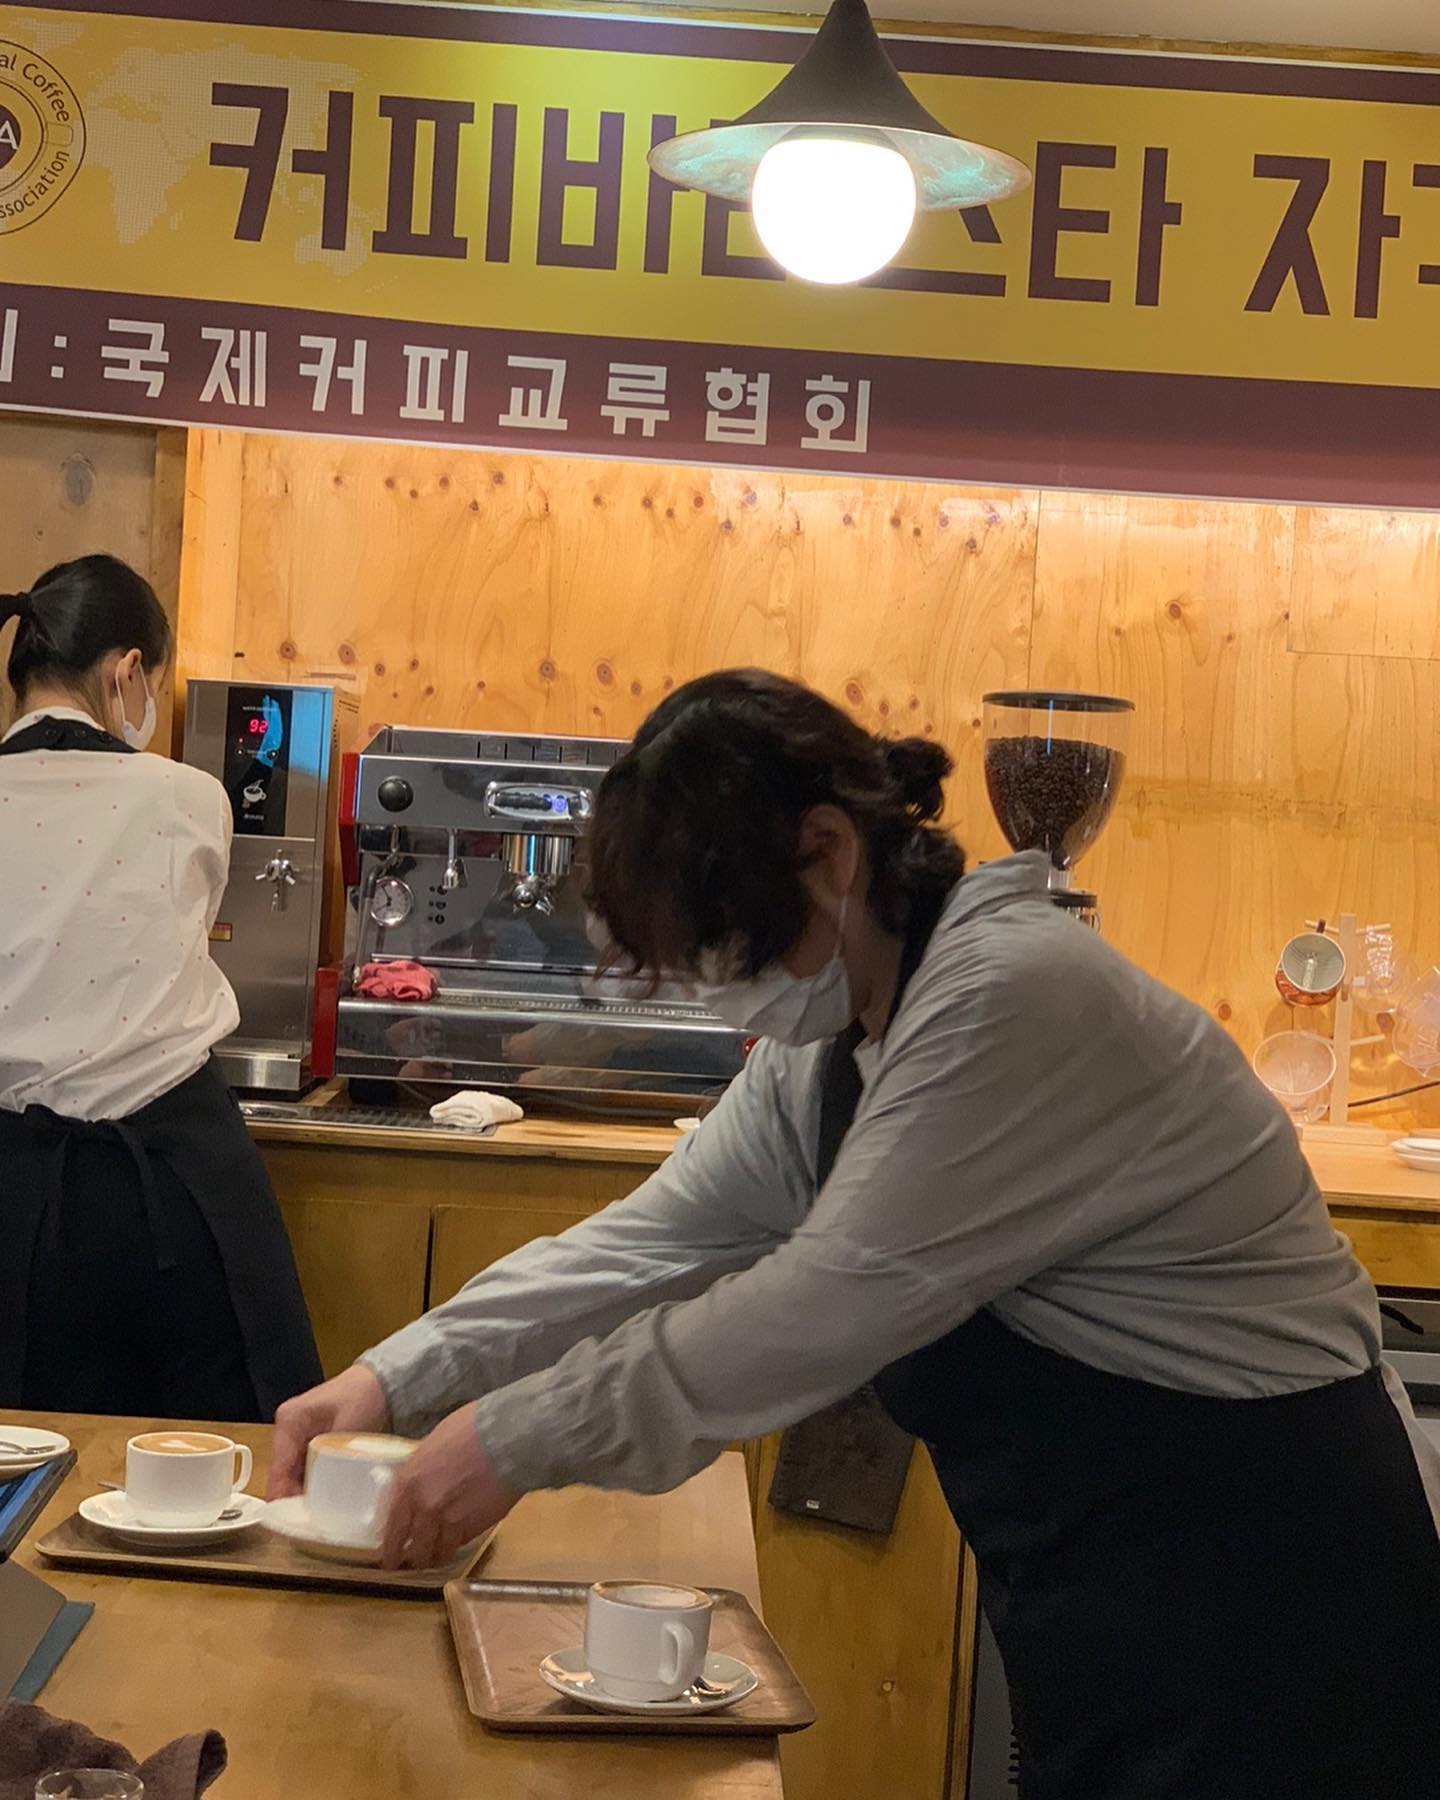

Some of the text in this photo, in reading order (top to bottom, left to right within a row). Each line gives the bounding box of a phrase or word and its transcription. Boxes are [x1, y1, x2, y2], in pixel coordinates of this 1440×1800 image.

[22, 63, 70, 122] Coffee
[208, 82, 1183, 307] 커피바스타
[249, 718, 269, 733] 92
